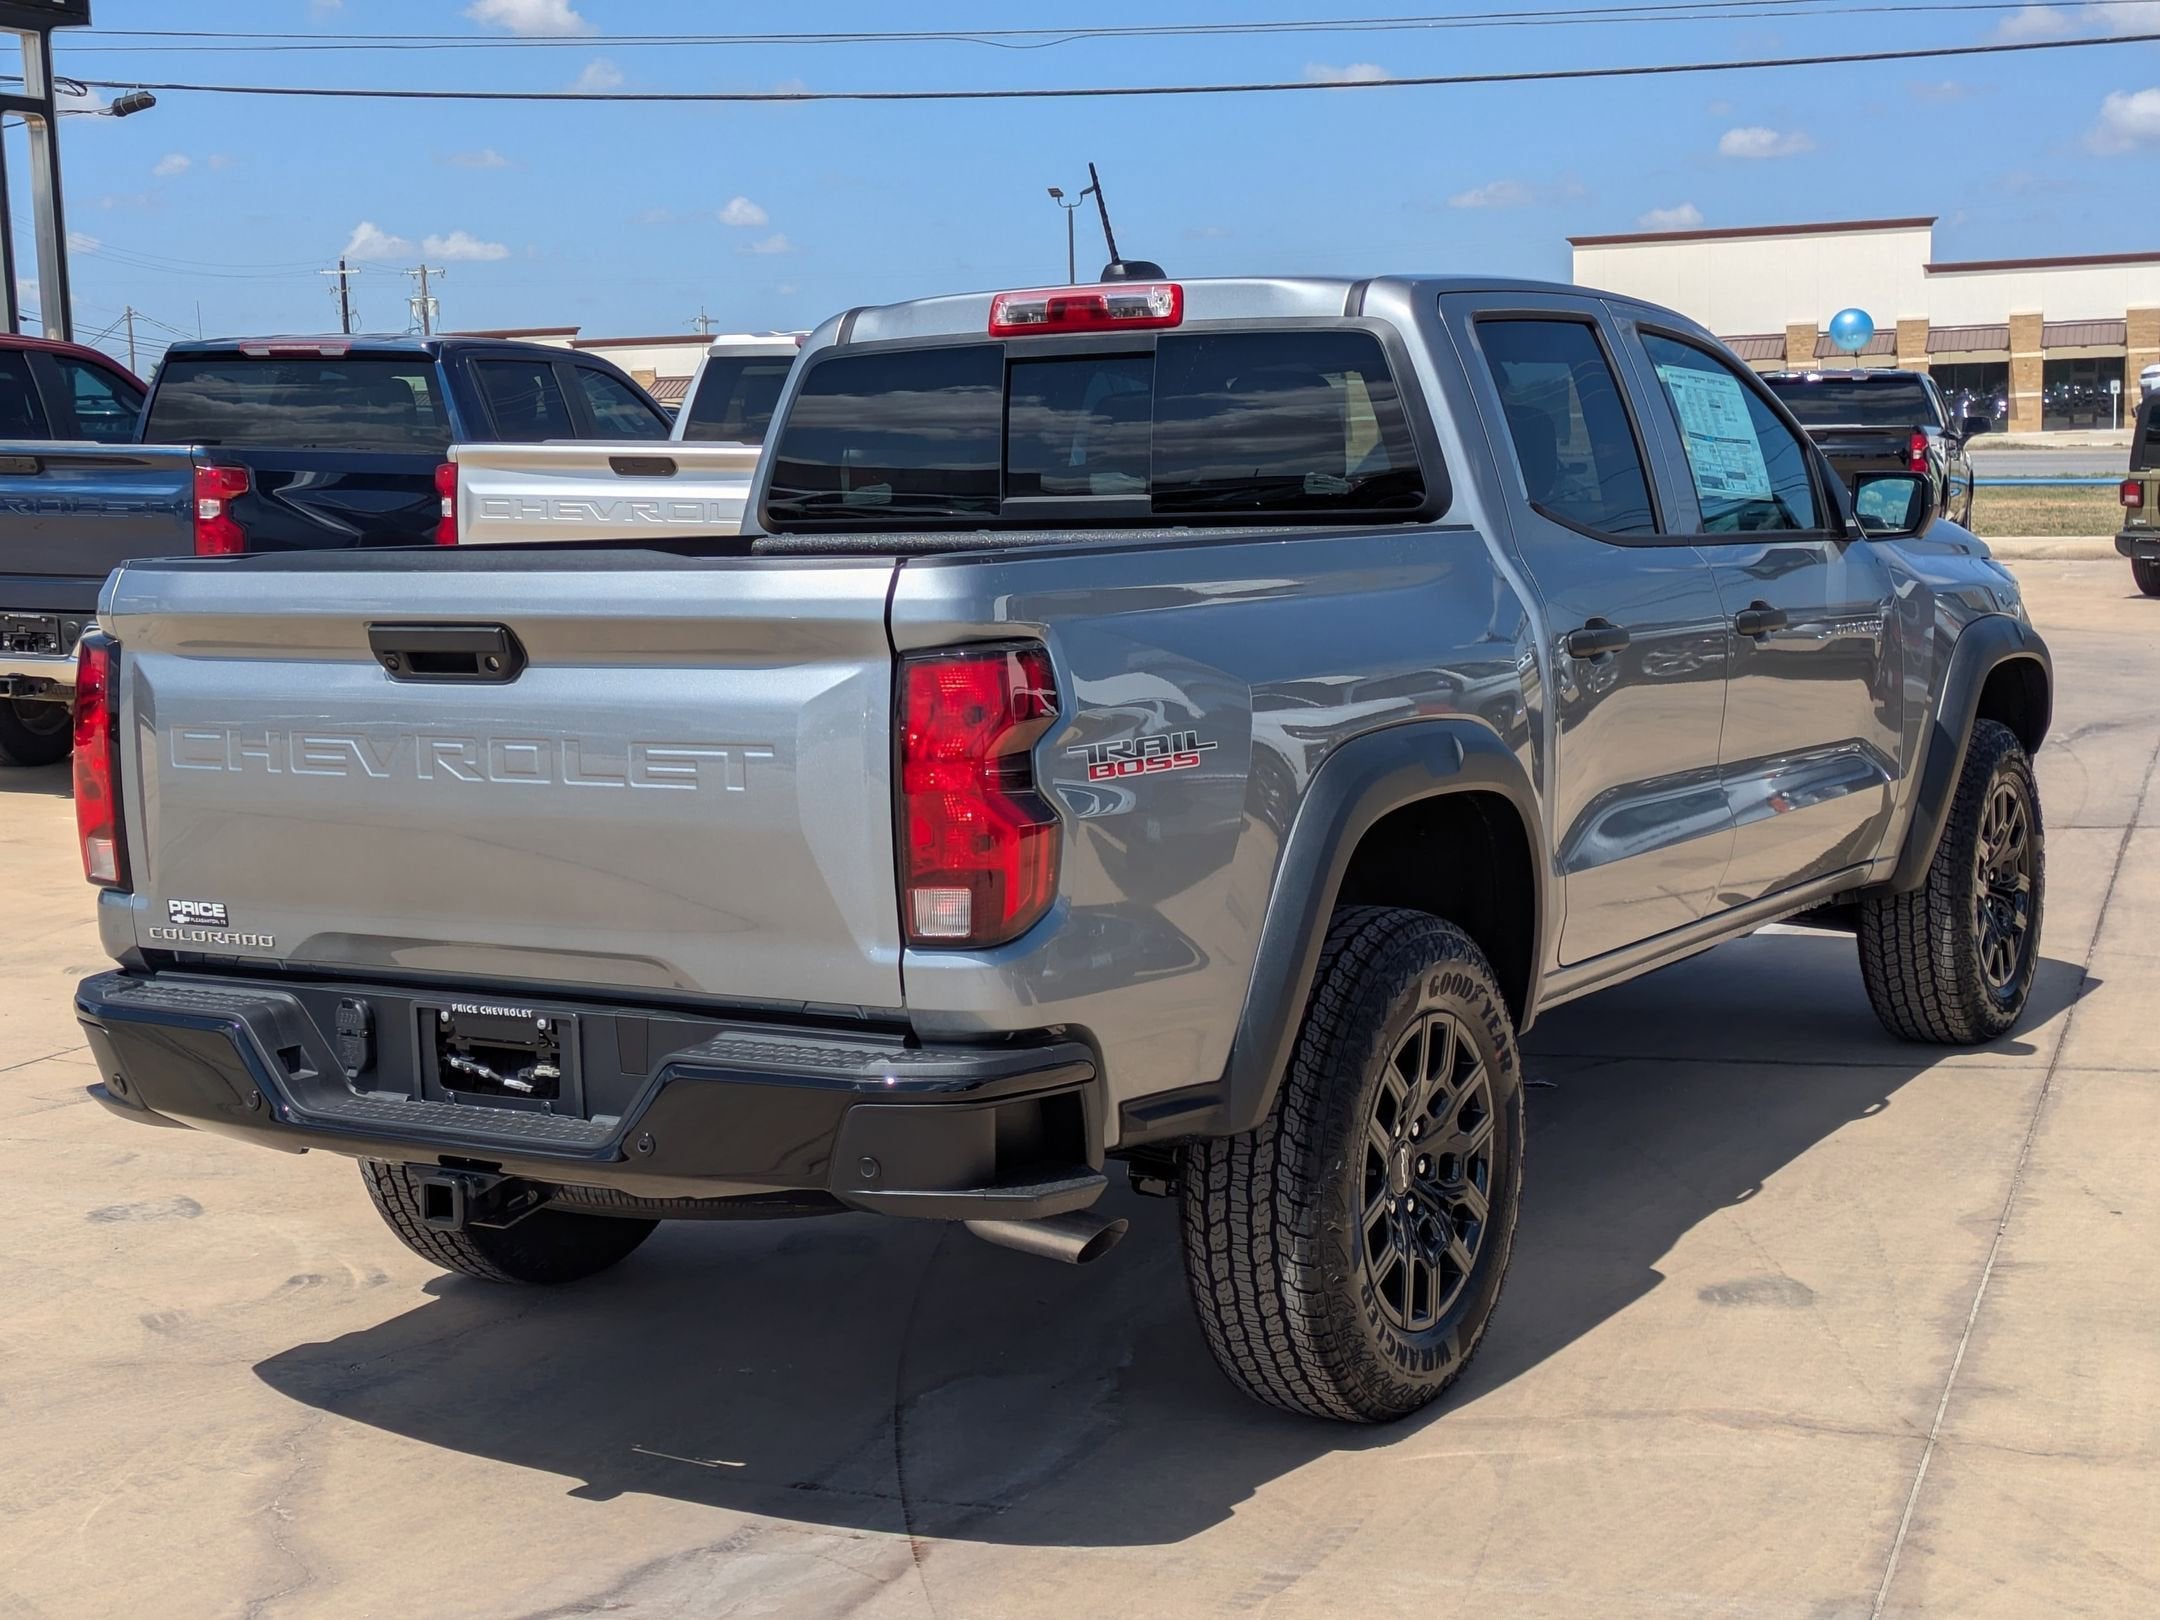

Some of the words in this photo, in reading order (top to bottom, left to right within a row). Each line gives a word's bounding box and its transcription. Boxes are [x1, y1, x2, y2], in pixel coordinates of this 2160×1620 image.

[480, 498, 742, 524] CHEVROL
[170, 725, 775, 792] CHEVROLET
[1067, 730, 1217, 764] TRAIL
[1088, 751, 1200, 781] BOSS
[168, 900, 225, 917] PRICE
[149, 927, 274, 946] COLORADO
[452, 1003, 478, 1014] PRICE
[480, 1006, 533, 1018] CHEVROLET
[1360, 1284, 1453, 1373] WRANGLER
